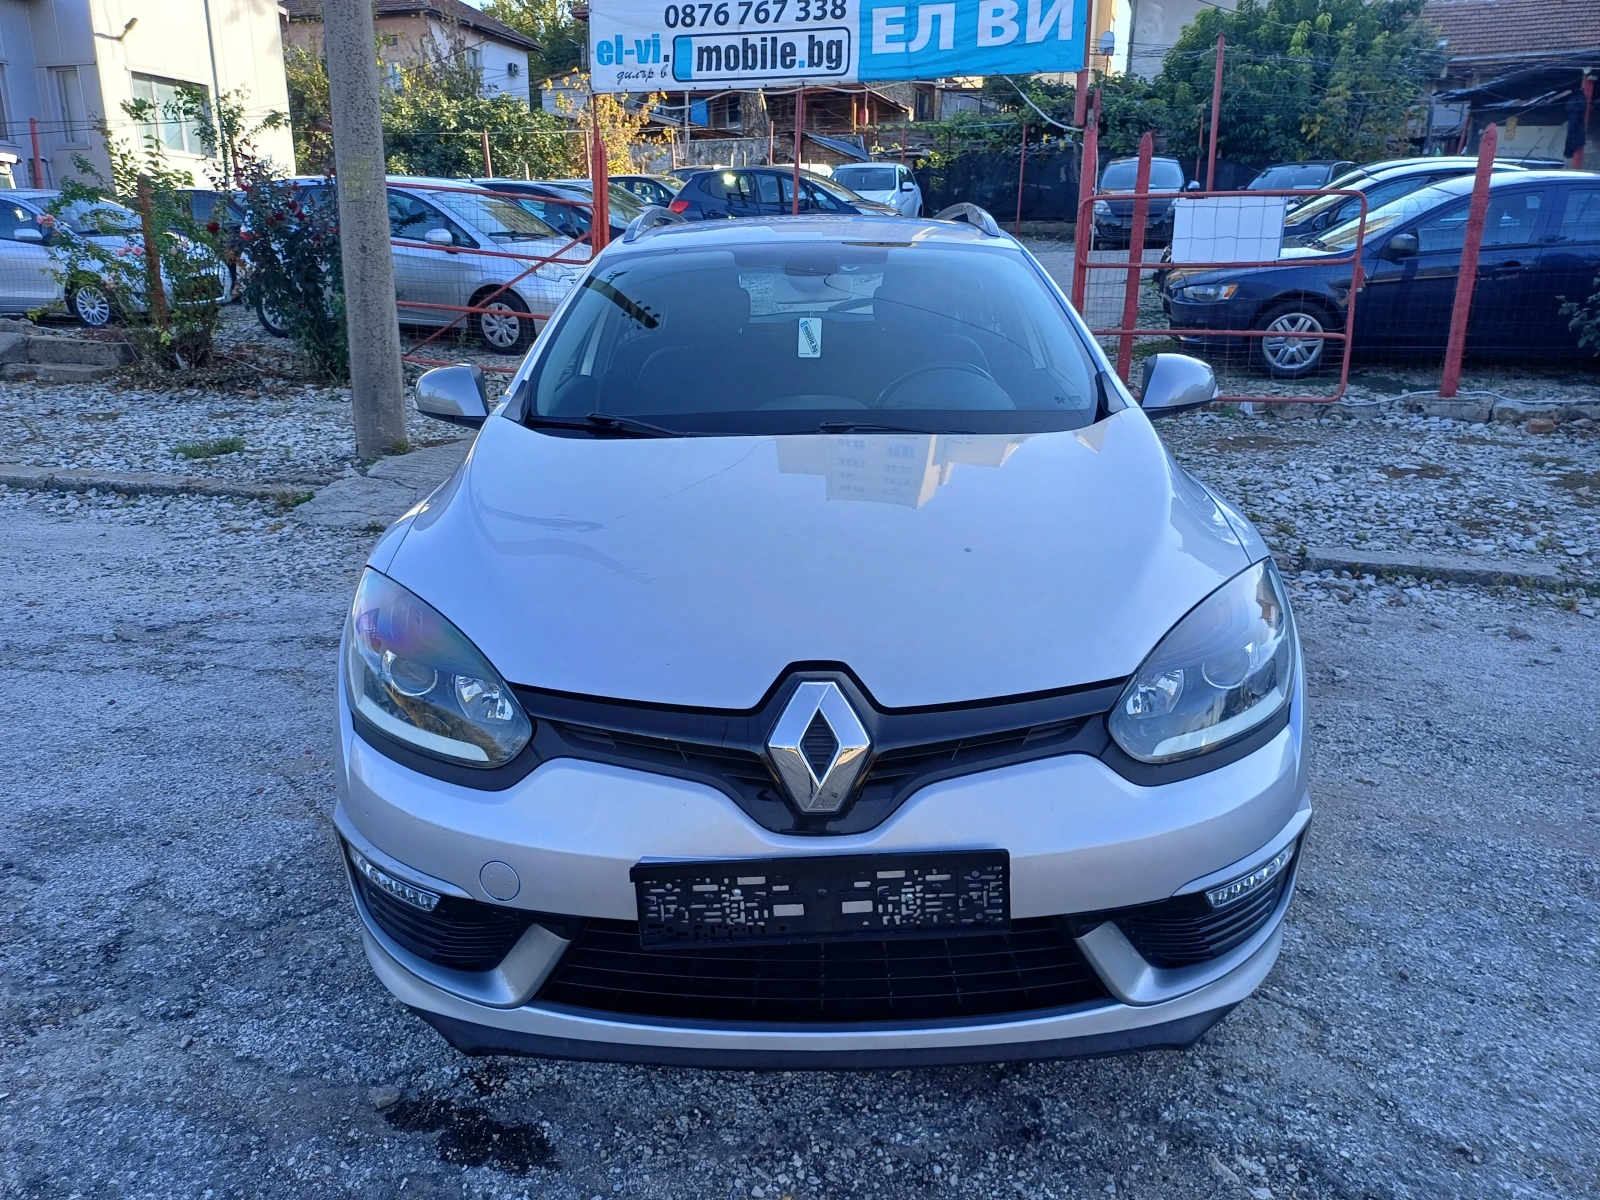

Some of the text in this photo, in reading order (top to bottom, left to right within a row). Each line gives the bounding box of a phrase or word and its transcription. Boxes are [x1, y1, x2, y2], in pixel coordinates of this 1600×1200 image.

[664, 0, 846, 28] 0876 767 338
[872, 0, 1074, 54] ЕЛ ВИ
[697, 34, 843, 71] mobile.bg
[616, 63, 669, 85] дилър в
